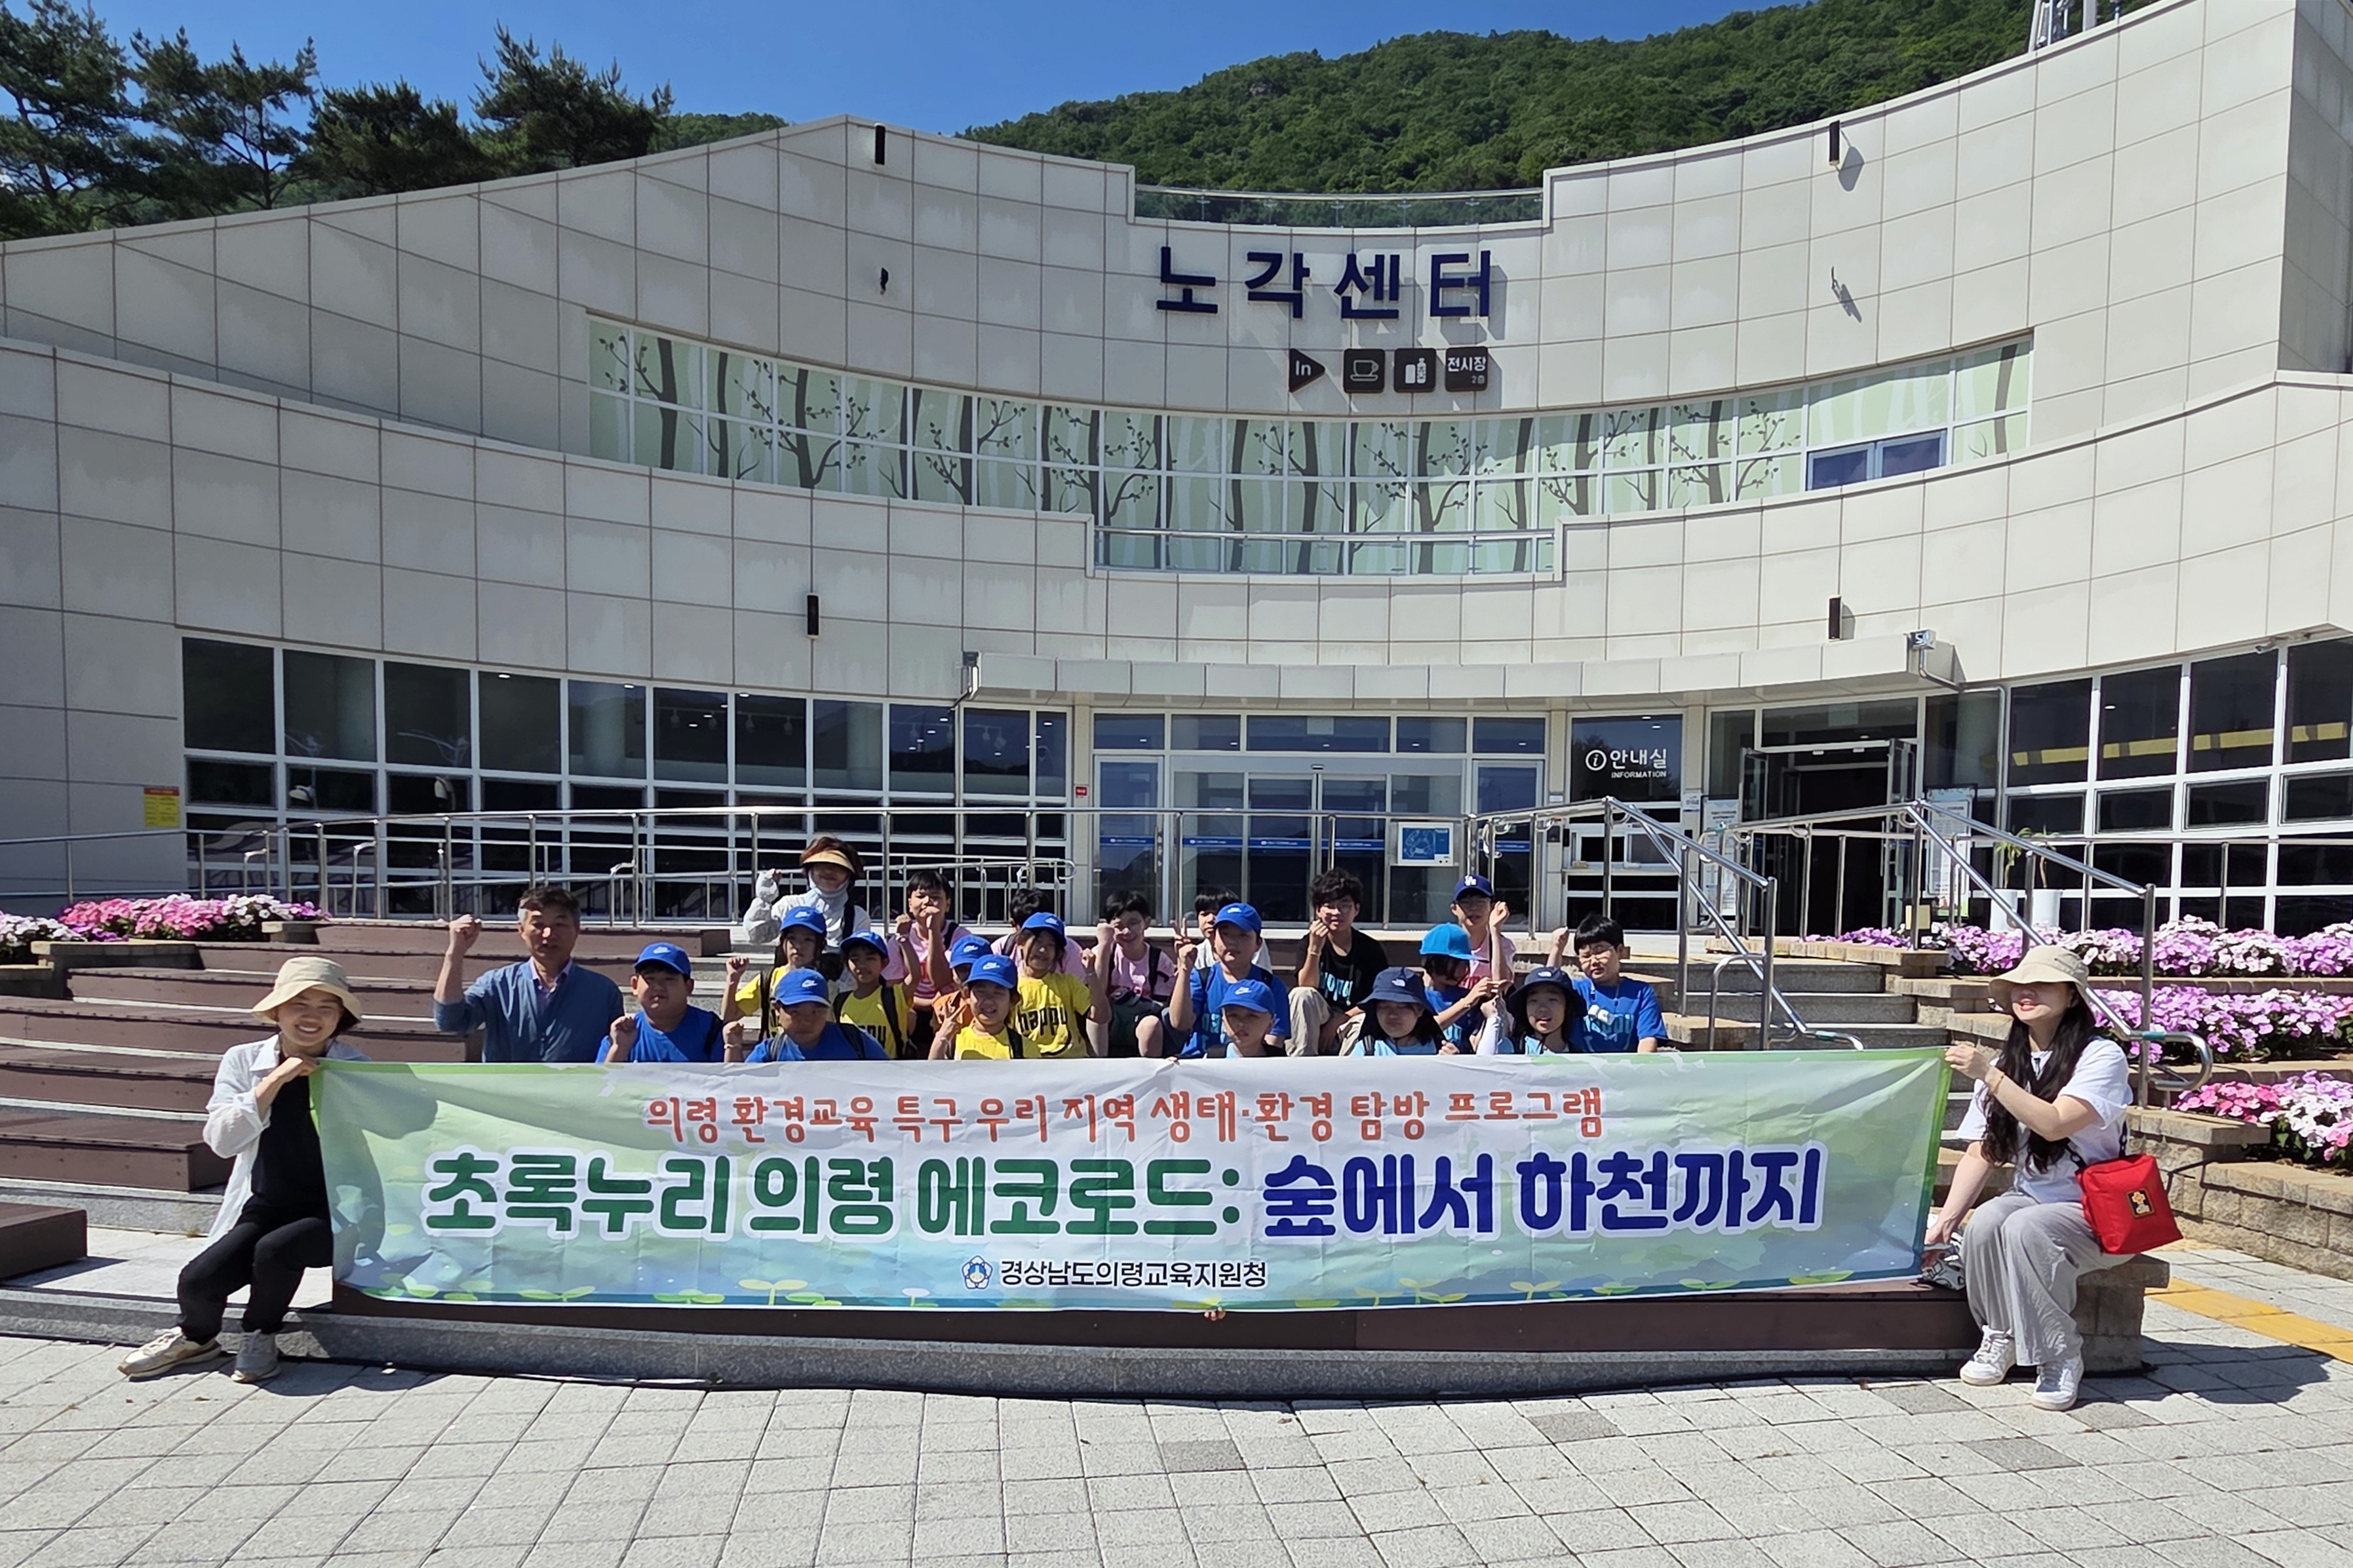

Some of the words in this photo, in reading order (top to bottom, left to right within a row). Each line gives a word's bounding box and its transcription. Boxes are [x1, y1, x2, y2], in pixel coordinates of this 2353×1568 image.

[1156, 245, 1491, 319] 노각센터
[1295, 360, 1312, 376] In
[1447, 356, 1487, 372] 전시장
[1610, 748, 1667, 769] 안내실
[648, 1096, 718, 1143] 의령
[732, 1096, 877, 1142] 환경교육
[892, 1096, 962, 1142] 특구
[976, 1095, 1047, 1141] 우리
[1064, 1094, 1135, 1141] 지역
[1351, 1092, 1430, 1141] 탐방
[1445, 1088, 1602, 1138] 프로그램
[427, 1152, 730, 1234] 초록누리
[750, 1156, 893, 1235] 의령
[918, 1156, 1239, 1236] 에코로드:
[1262, 1152, 1494, 1237] 숲에서
[1515, 1148, 1821, 1233] 하천까지
[1000, 1260, 1266, 1288] 경상남도의령교육지원청
